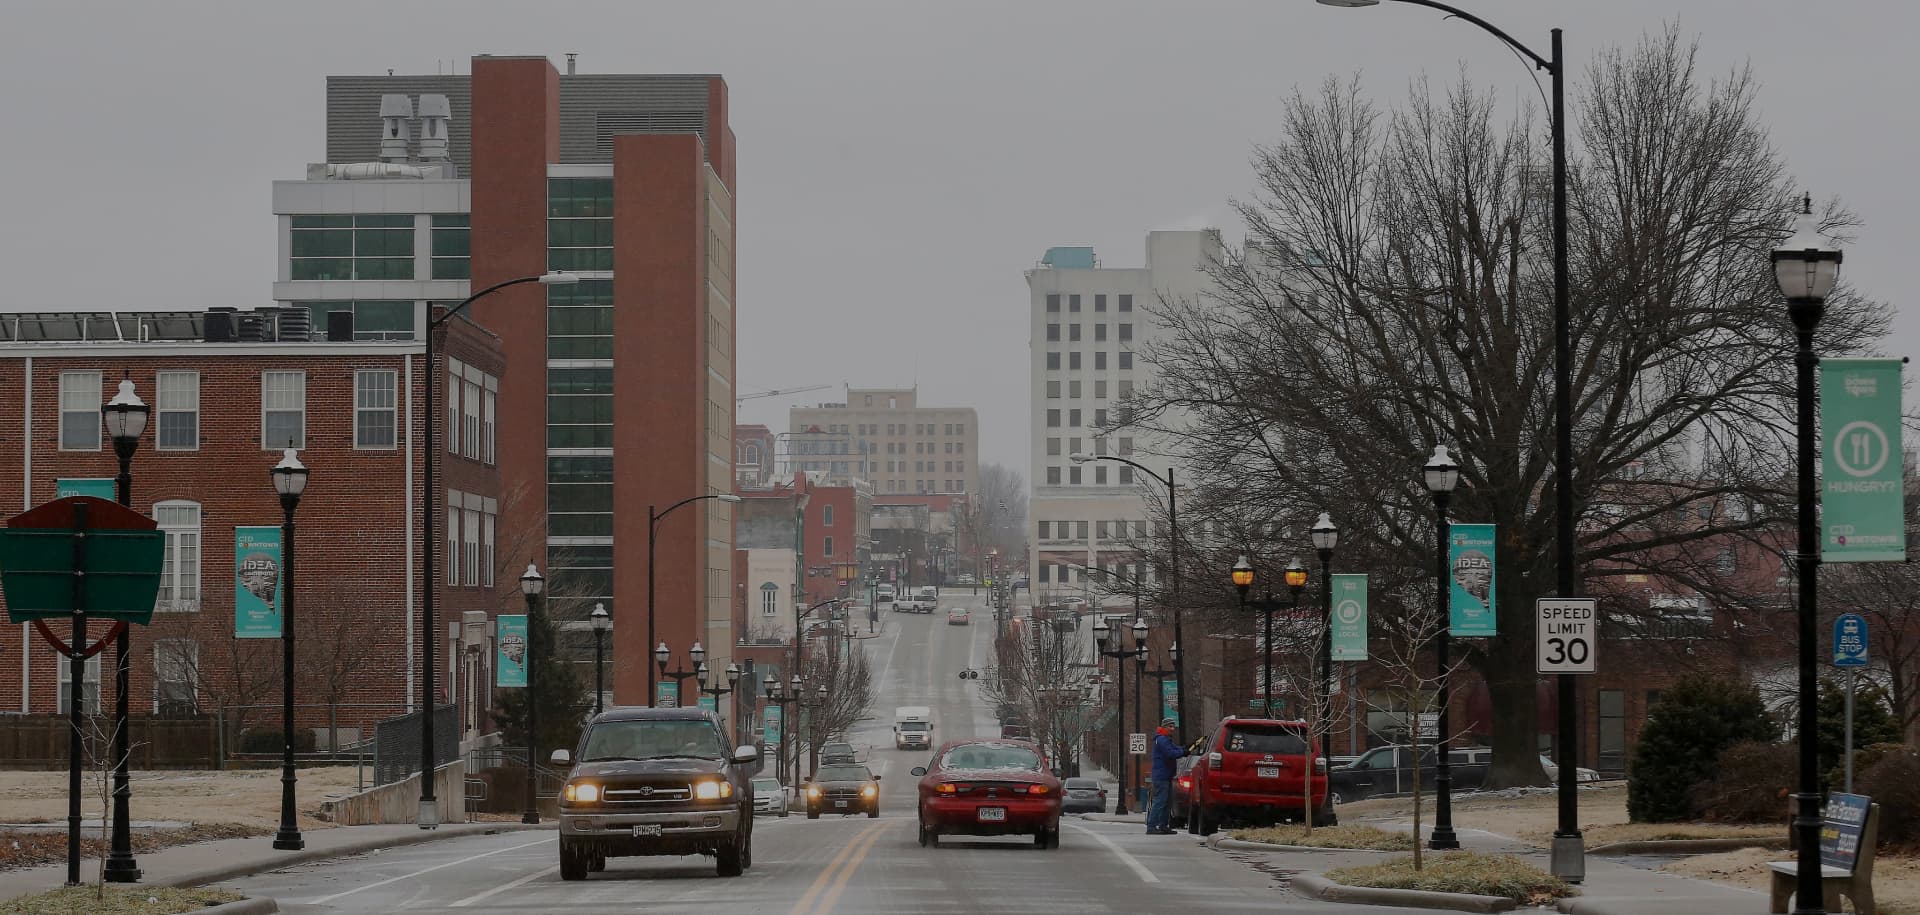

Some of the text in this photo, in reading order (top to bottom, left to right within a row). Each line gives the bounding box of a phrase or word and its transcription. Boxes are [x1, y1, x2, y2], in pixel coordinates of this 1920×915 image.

[1828, 481, 1896, 493] HUNGRY?
[1829, 535, 1897, 545] DOWNTOWN
[243, 560, 274, 570] IDEA
[1458, 558, 1488, 568] IDEA
[1543, 608, 1591, 619] SPEED
[1548, 623, 1586, 634] LIMIT
[1841, 635, 1860, 644] BUS
[1545, 637, 1589, 665] 30
[1839, 644, 1863, 653] STOP
[1131, 743, 1145, 752] 20
